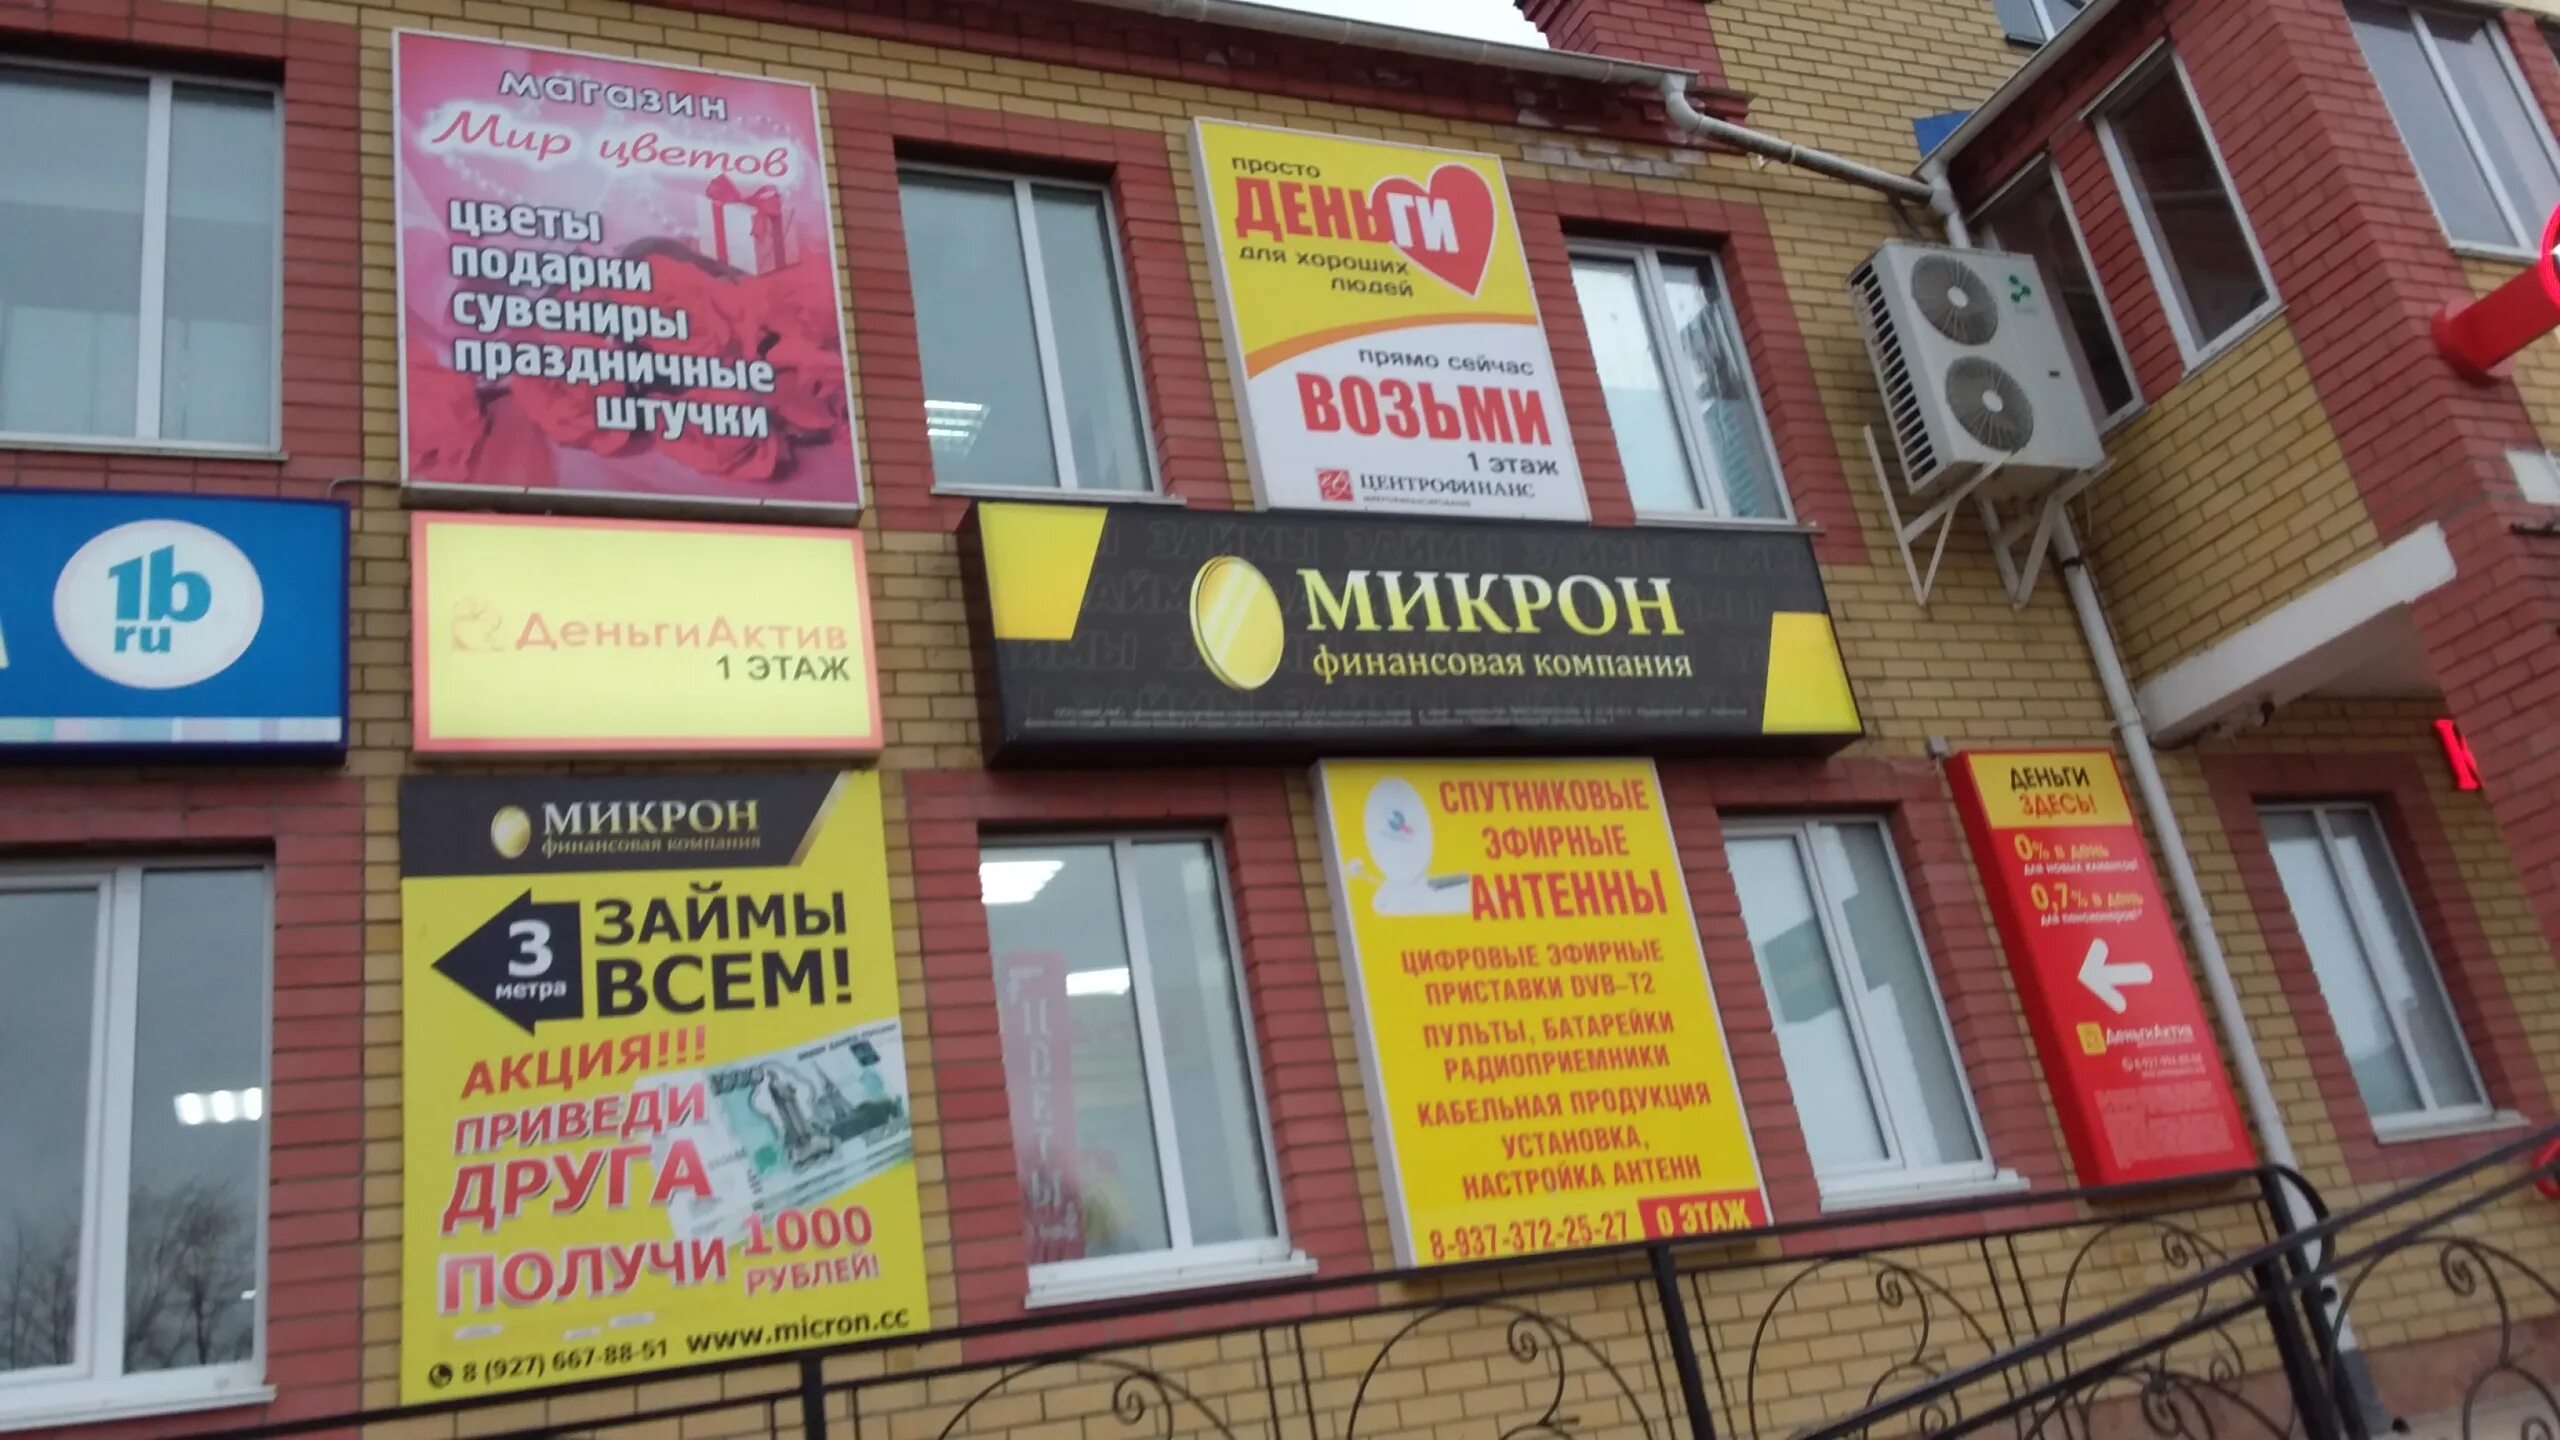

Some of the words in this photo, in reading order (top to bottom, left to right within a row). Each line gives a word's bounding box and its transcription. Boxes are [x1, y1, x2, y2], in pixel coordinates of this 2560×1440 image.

[499, 70, 728, 121] магазин
[432, 110, 572, 160] Мир
[599, 131, 790, 177] цветов
[1232, 156, 1321, 178] просто
[449, 198, 602, 242] цветы
[1235, 176, 1459, 255] ДЕНЬГИ
[450, 244, 652, 293] подарки
[1239, 245, 1287, 263] для
[1296, 251, 1409, 275] хороших
[1331, 277, 1414, 298] людей
[453, 291, 689, 343] сувениры
[454, 338, 776, 392] праздничные
[1359, 348, 1439, 369] прямо
[1448, 355, 1535, 377] сейчас
[596, 396, 769, 441] штучки
[1296, 372, 1552, 446] ВОЗЬМИ
[1360, 473, 1536, 498] ЦЕНТРОФИНАНС
[1467, 452, 1479, 471] 1
[1488, 456, 1559, 476] этаж
[108, 545, 212, 622] 1b
[1296, 567, 1685, 637] МИКРОН
[114, 624, 171, 653] ru
[514, 611, 849, 651] ДеньгиАктив
[715, 655, 731, 680] 1
[746, 654, 851, 682] ЭТАЖ
[1312, 648, 1526, 686] финансовая
[1533, 649, 1694, 680] компания
[1439, 777, 1650, 814] СПУТНИКОВЫЕ
[2010, 766, 2090, 792] ДЕНЬГИ
[542, 799, 760, 835] МИКРОН
[2020, 793, 2098, 819] ЗДЕСЬ!
[540, 834, 661, 859] финансовая
[666, 833, 761, 853] компания
[1481, 824, 1629, 861] ЭФИРНЫЕ
[593, 881, 847, 946] ЗАЙМЫ
[1470, 868, 1668, 921] АНТЕННЫ
[507, 918, 554, 978] 3
[1401, 943, 1539, 978] ЦИФРОВЫЕ
[1547, 939, 1663, 966] ЭФИРНЫЕ
[494, 979, 567, 1002] метра
[595, 947, 853, 1019] ВСЕМ!
[1425, 975, 1563, 1006] ПРИСТАВКИ
[1571, 971, 1656, 998] DVB-T2
[1423, 1018, 1536, 1049] ПУЛЬТЫ,
[1543, 1009, 1674, 1041] БАТАРЕЙКИ
[460, 1024, 707, 1098] АКЦИЯ!!!
[1444, 1044, 1670, 1085] РАДИОПРИЕМНИКИ
[453, 1080, 707, 1155] ПРИВЕДИ
[1417, 1091, 1562, 1128] КАБЕЛЬНАЯ
[1570, 1082, 1711, 1117] ПРОДУКЦИЯ
[1502, 1123, 1650, 1161] УСТАНОВКА,
[440, 1138, 715, 1235] ДРУГА
[1462, 1160, 1604, 1201] НАСТРОЙКА
[1613, 1154, 1701, 1184] АНТЕНН
[1429, 1210, 1628, 1263] 8-937-372-25-27
[1679, 1198, 1752, 1234] ЭТАЖ
[439, 1235, 728, 1316] ПОЛУЧИ
[744, 1205, 873, 1258] 1000
[745, 1250, 880, 1297] РУБЛЕЙ!
[462, 1362, 477, 1382] 8
[484, 1353, 546, 1384] (927)
[552, 1337, 667, 1371] 667-88-51
[686, 1307, 910, 1356] www.micron.cc
